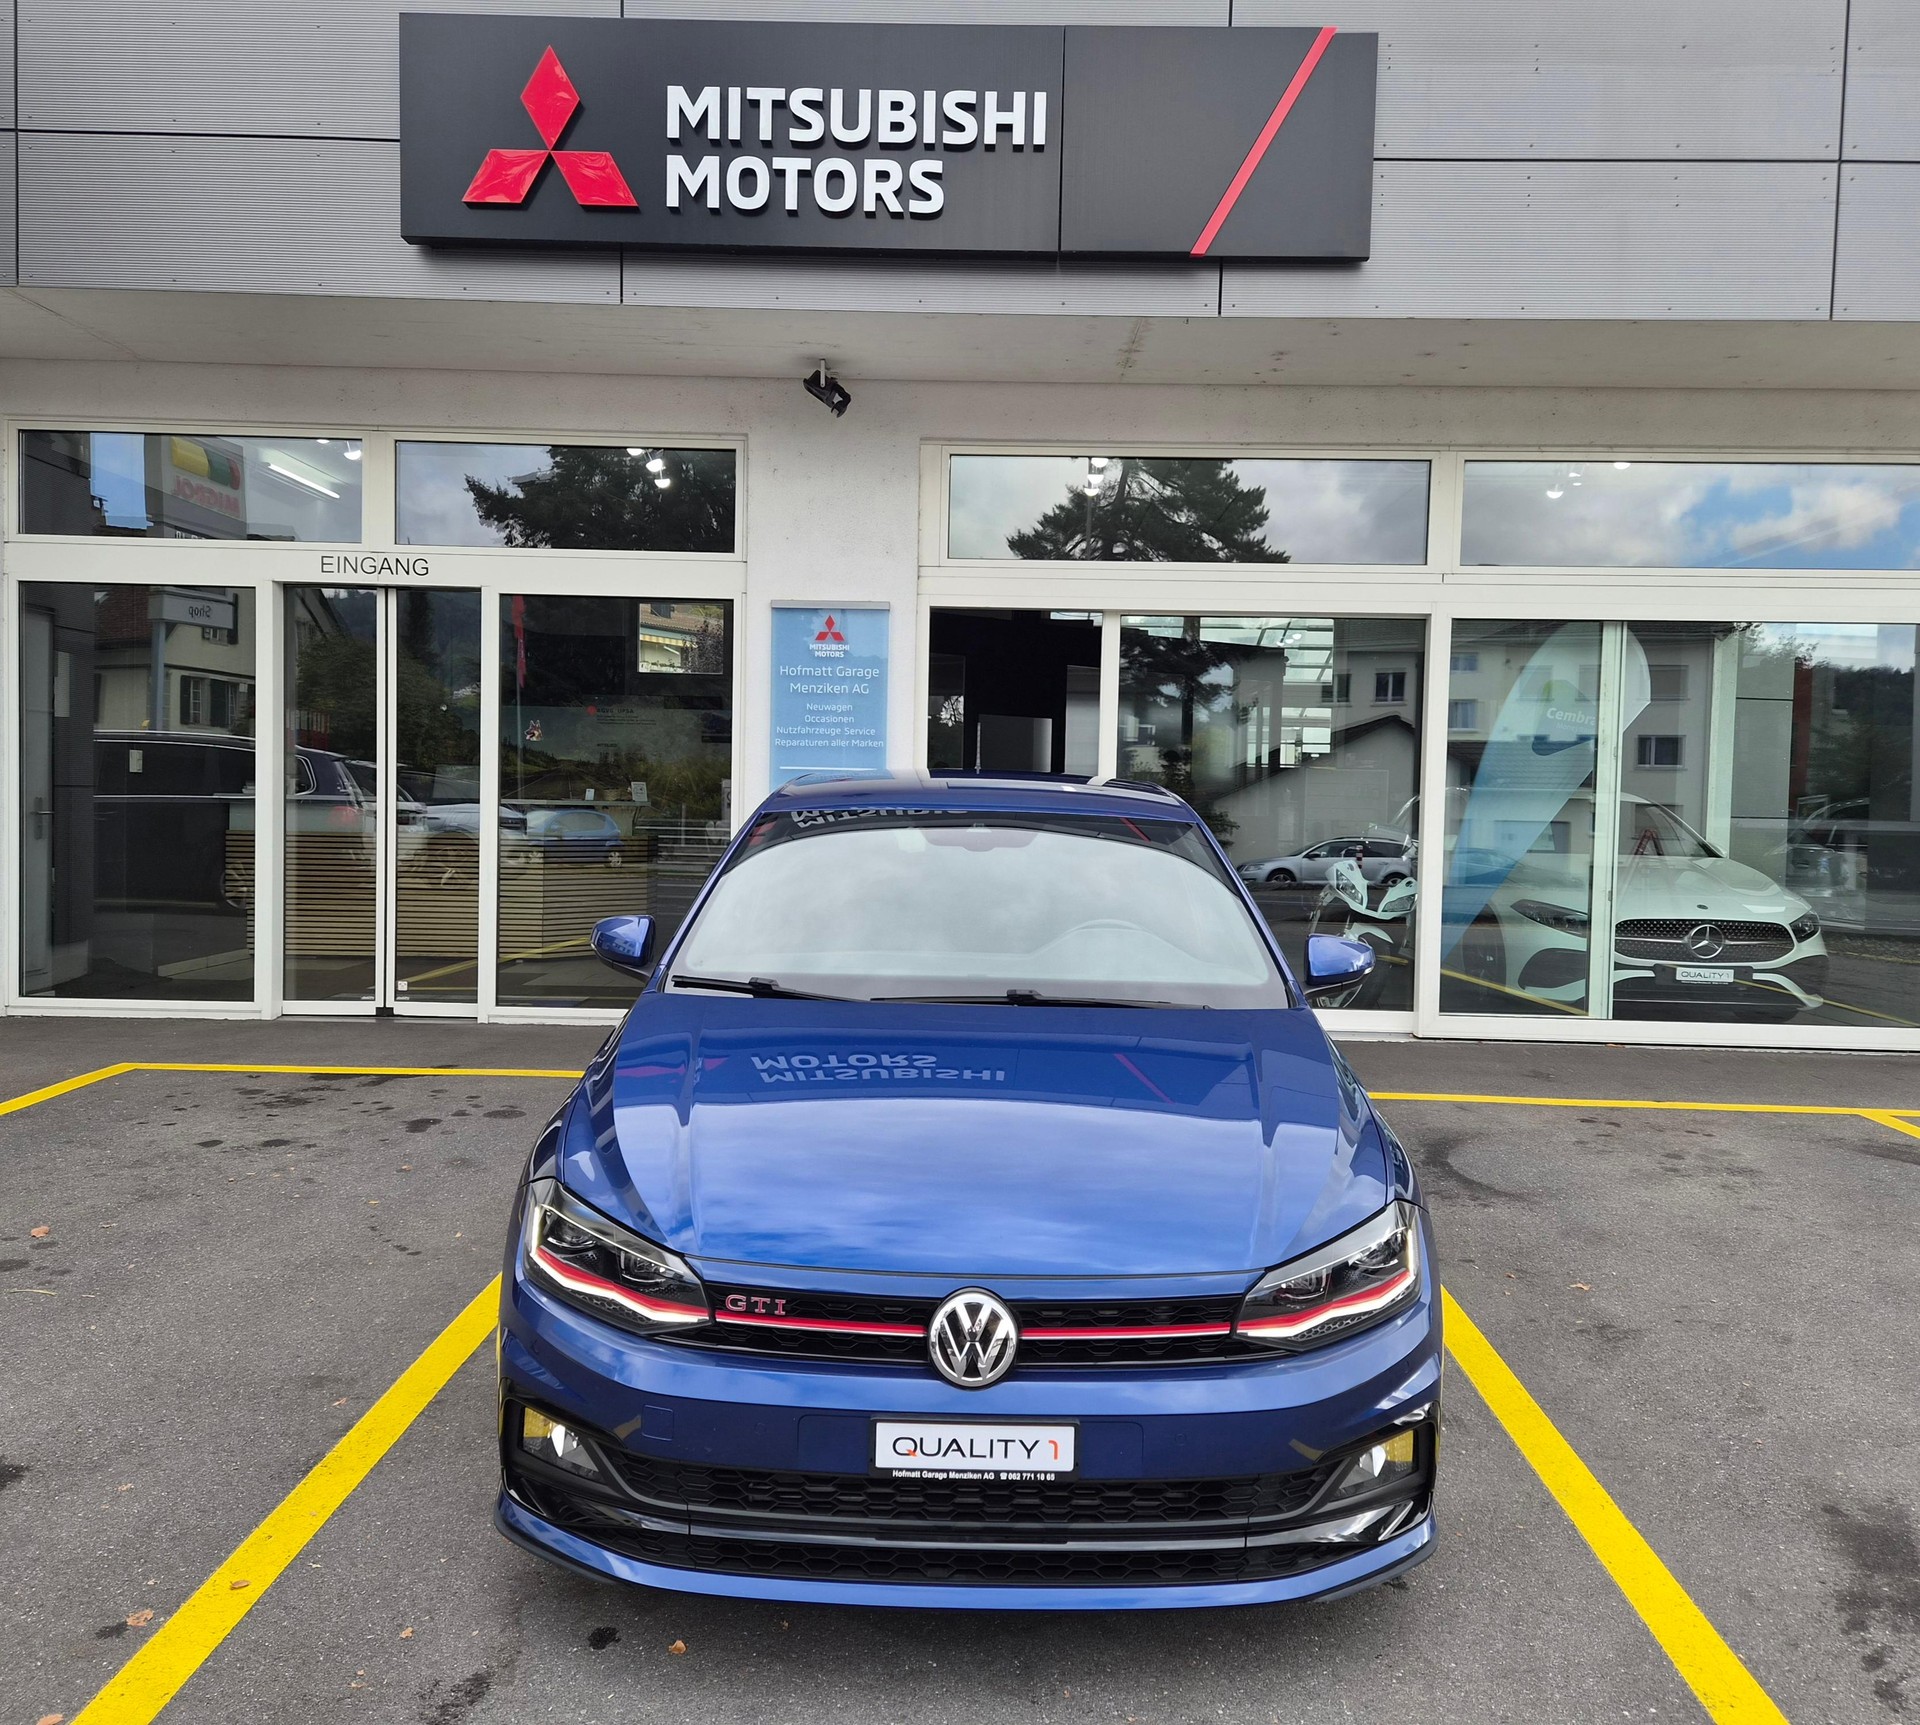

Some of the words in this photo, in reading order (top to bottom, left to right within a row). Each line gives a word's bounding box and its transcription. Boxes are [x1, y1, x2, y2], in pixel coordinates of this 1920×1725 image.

[666, 85, 1047, 146] MITSUBISHI
[666, 154, 944, 214] MOTORS
[321, 555, 429, 577] EINGANG
[780, 665, 833, 677] Hofmatt
[836, 666, 880, 679] Garage
[789, 683, 849, 694] Menziken
[852, 684, 869, 694] AG
[806, 703, 853, 713] Neuwagen
[804, 715, 855, 723] Occasionen
[776, 726, 842, 736] Nutzfahrzeuge
[844, 727, 876, 736] Service
[775, 739, 829, 748] Reparaturen
[831, 739, 850, 747] aller
[851, 740, 884, 748] Marken
[725, 1294, 786, 1316] GTI
[892, 1437, 1040, 1459] QUALITY
[1048, 1440, 1058, 1460] 1
[892, 1470, 920, 1478] Hofmatt
[922, 1471, 947, 1480] Garage
[949, 1471, 982, 1479] Menziken
[1022, 1472, 1034, 1480] 771
